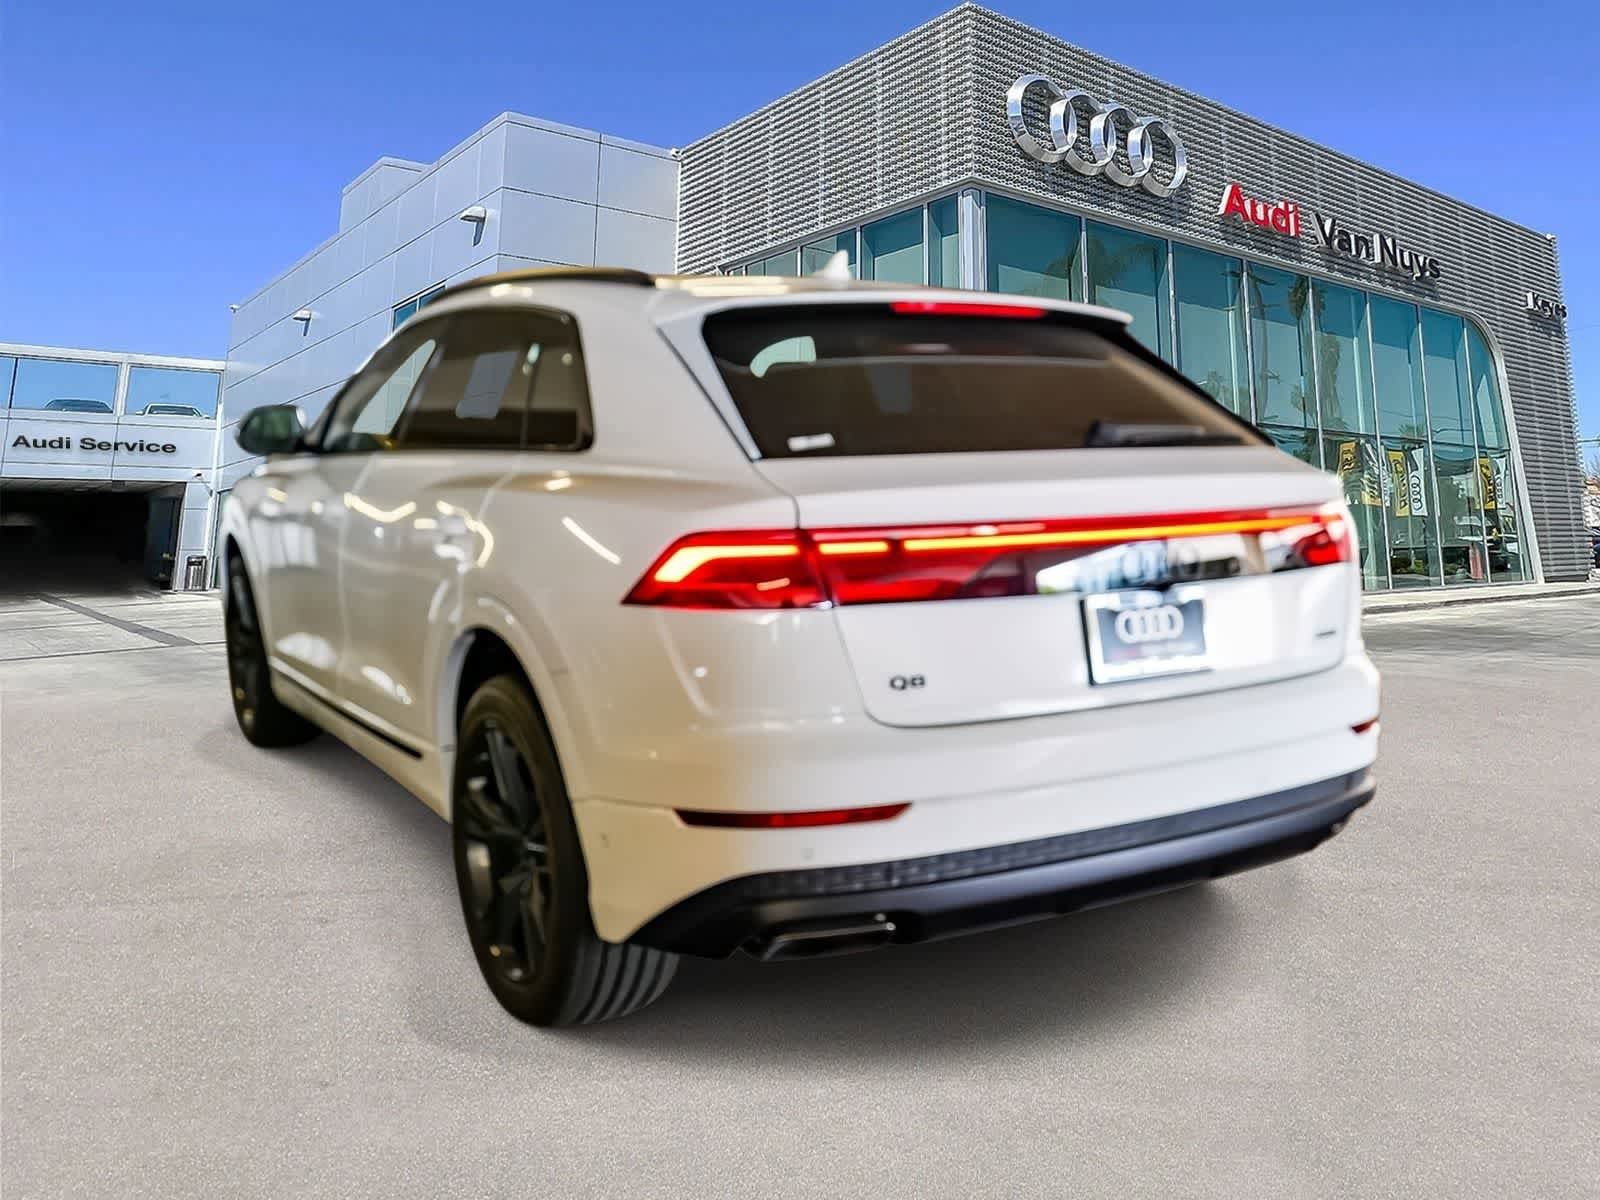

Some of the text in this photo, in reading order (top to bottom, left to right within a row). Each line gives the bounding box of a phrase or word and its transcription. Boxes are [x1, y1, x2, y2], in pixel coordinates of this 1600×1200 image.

[1218, 181, 1442, 280] Audi Van Nuys
[12, 434, 177, 454] Audi Service
[889, 674, 925, 691] Q8
